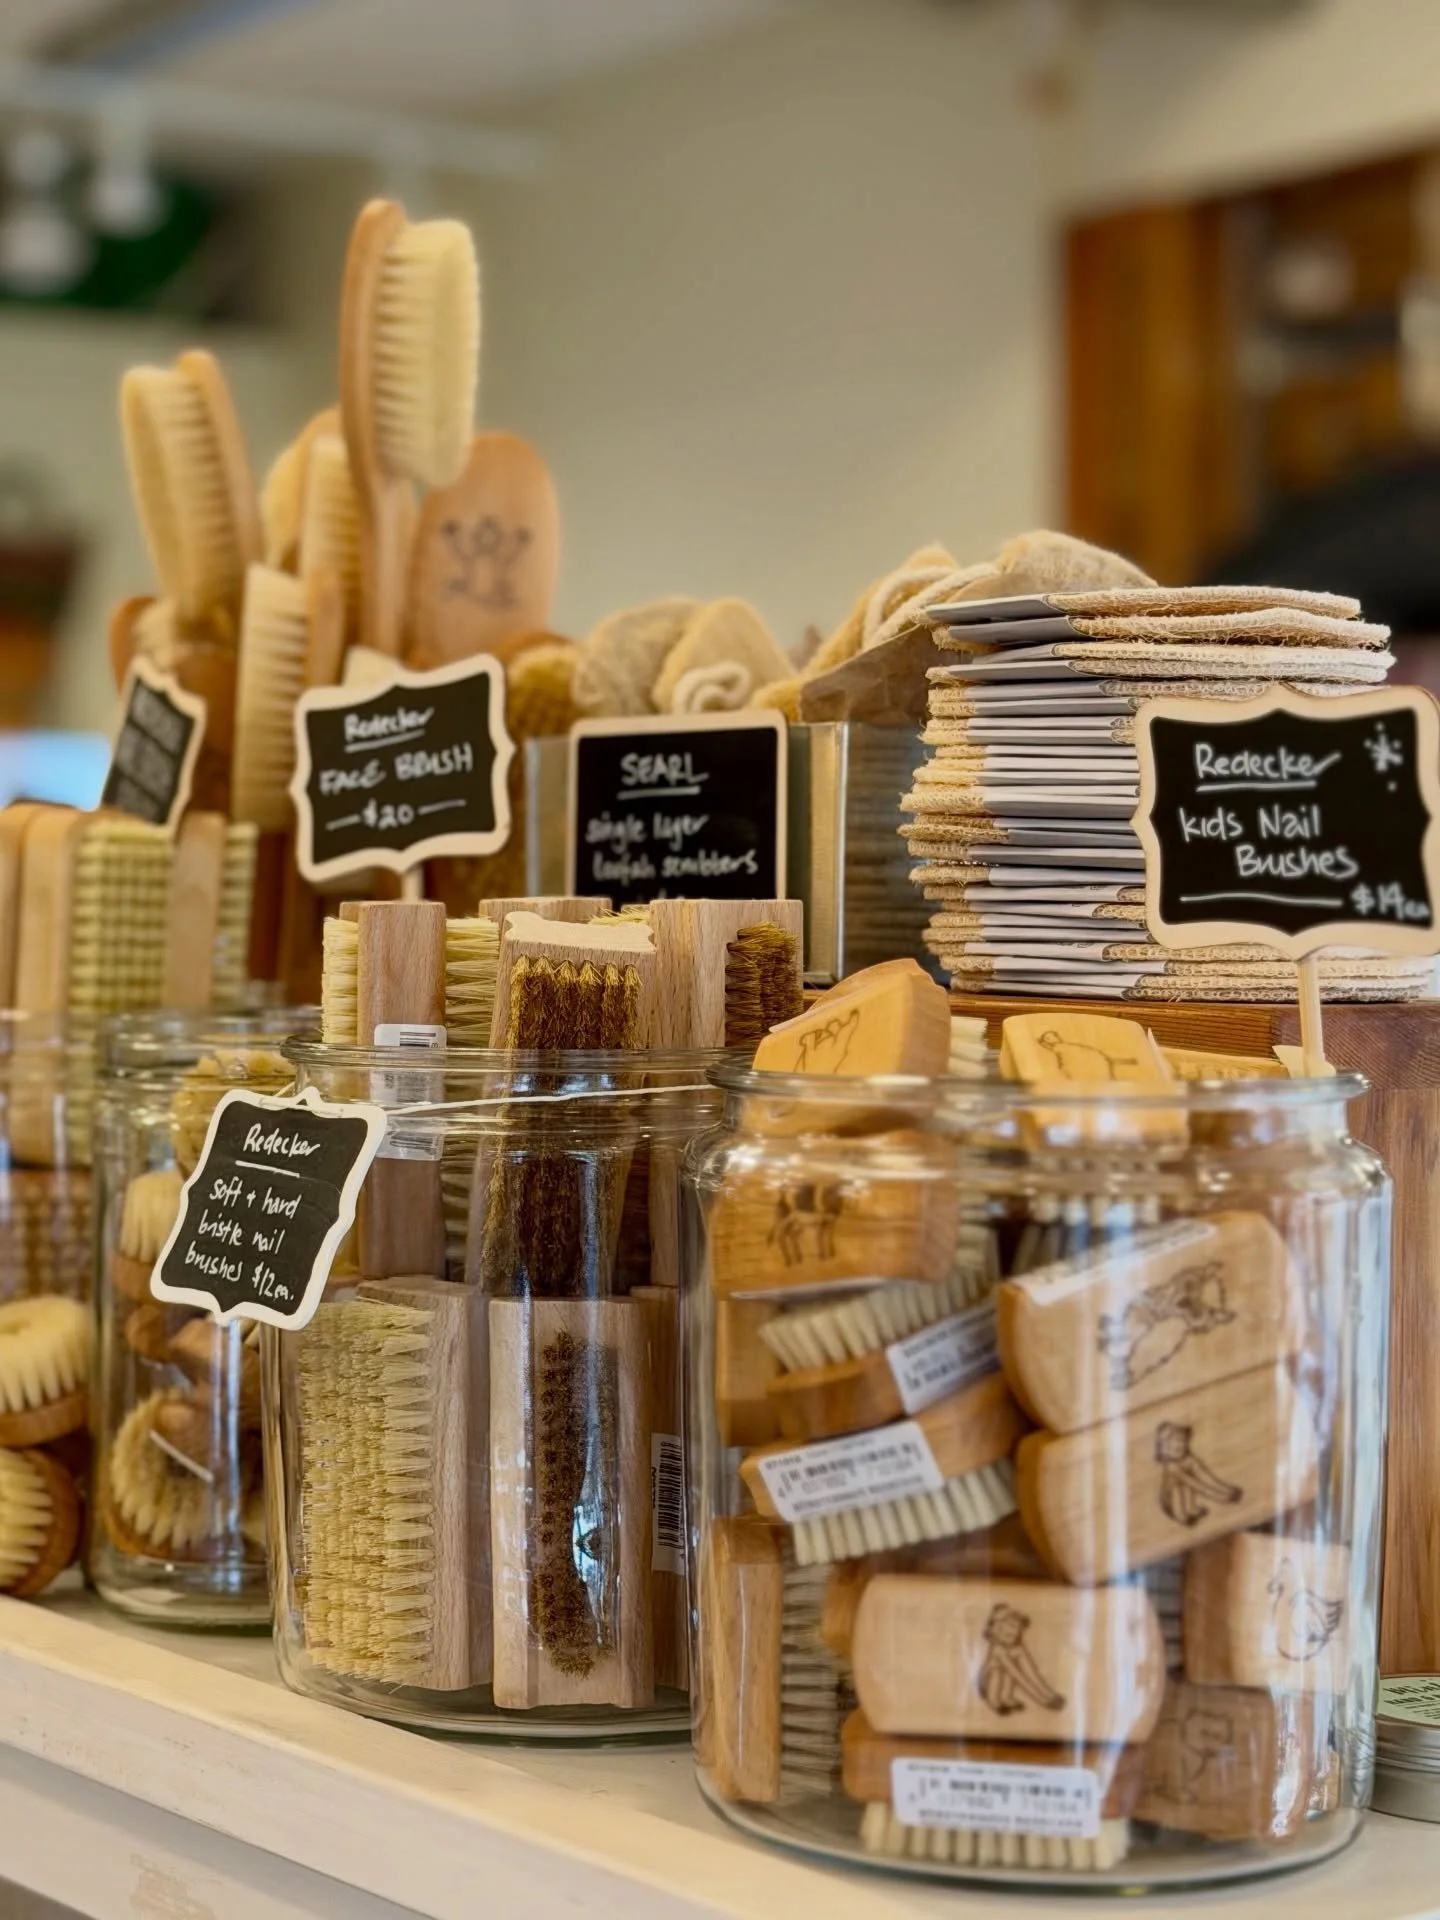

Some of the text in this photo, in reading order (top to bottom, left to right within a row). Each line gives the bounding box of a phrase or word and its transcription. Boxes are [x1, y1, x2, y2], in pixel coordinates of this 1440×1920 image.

[344, 706, 435, 743] Redecker
[319, 741, 474, 796] FACE BRUSH
[1194, 742, 1342, 779] Redecker
[363, 798, 415, 830] $20
[1179, 804, 1321, 842] kids Nail
[1235, 844, 1359, 880] Brushes
[242, 1122, 321, 1158] Redecker
[209, 1176, 244, 1208] soft
[261, 1186, 302, 1219] hard
[197, 1208, 286, 1255] bristle nail
[184, 1240, 243, 1283] brushes
